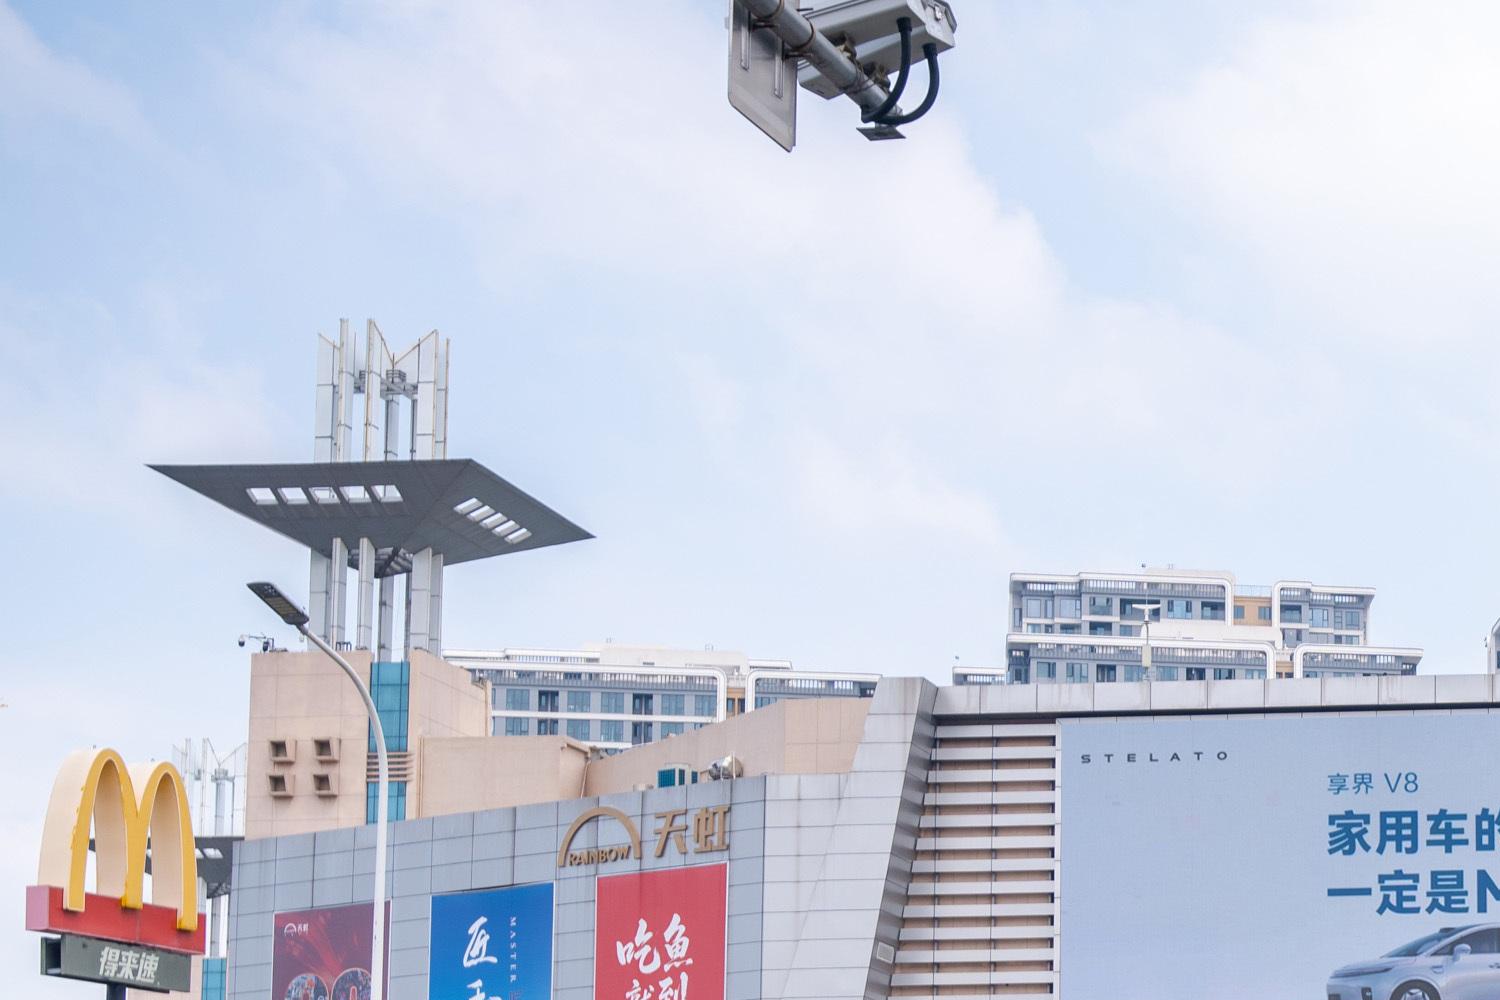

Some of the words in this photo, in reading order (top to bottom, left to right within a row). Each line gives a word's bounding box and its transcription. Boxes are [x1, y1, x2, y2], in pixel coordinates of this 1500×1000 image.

[1081, 751, 1228, 764] STELATO
[1327, 772, 1374, 795] 享界
[1384, 771, 1419, 794] V8
[654, 804, 732, 858] 天虹
[568, 844, 633, 865] RAINBOW
[98, 945, 160, 984] 得来速
[509, 916, 517, 982] MASTER
